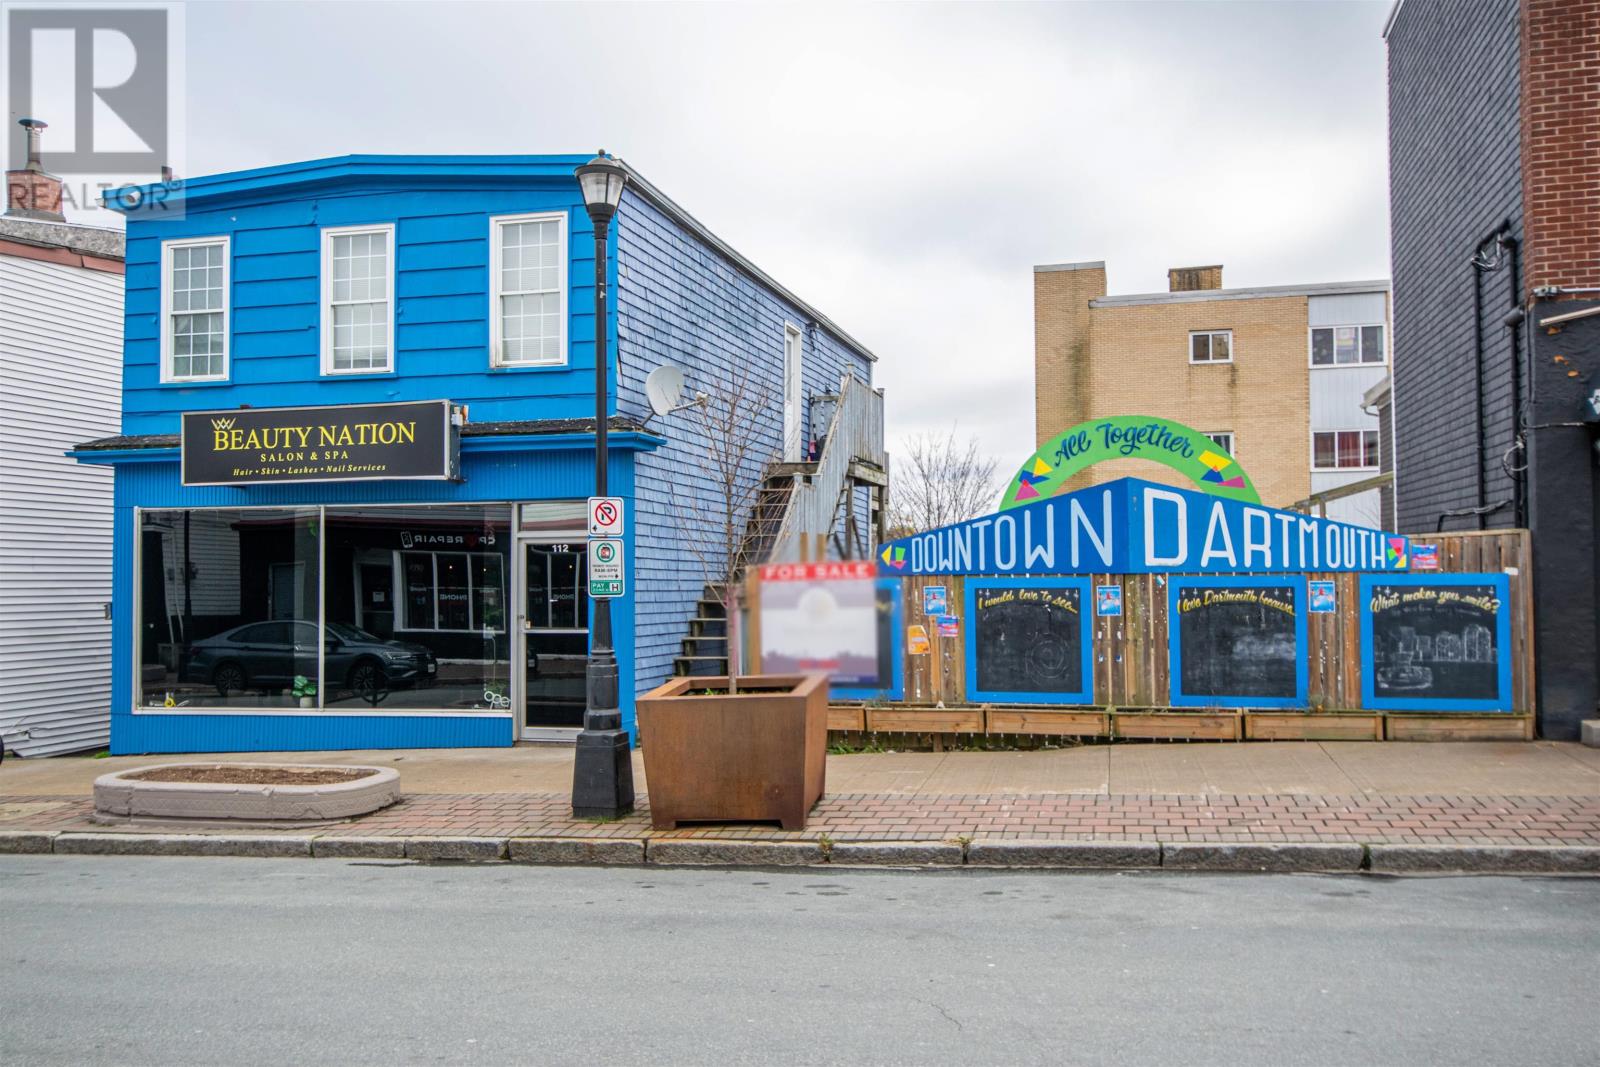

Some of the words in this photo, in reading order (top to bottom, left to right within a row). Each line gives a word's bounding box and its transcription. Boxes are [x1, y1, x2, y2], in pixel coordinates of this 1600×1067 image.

[213, 426, 313, 451] BEAUTY
[318, 421, 416, 447] NATION
[1054, 430, 1092, 468] All
[1096, 422, 1195, 459] Together
[260, 452, 304, 463] SALON
[310, 451, 318, 461] &
[324, 450, 349, 460] SPA
[233, 467, 254, 476] Hair
[260, 466, 280, 475] Skin
[287, 465, 319, 475] Lashes
[326, 464, 346, 473] Nail
[347, 463, 386, 472] Services
[911, 489, 1113, 573] DOWNTOWN
[1143, 487, 1386, 570] DARTMOUTH
[552, 544, 569, 553] 112
[765, 565, 806, 578] FOR
[814, 564, 869, 578] SALE
[984, 589, 1015, 608] would
[1019, 588, 1039, 600] love
[1182, 598, 1202, 613] love
[1203, 589, 1258, 606] Dartmouth
[1370, 592, 1400, 613] What
[1402, 587, 1438, 603] makes
[1437, 590, 1460, 605] you
